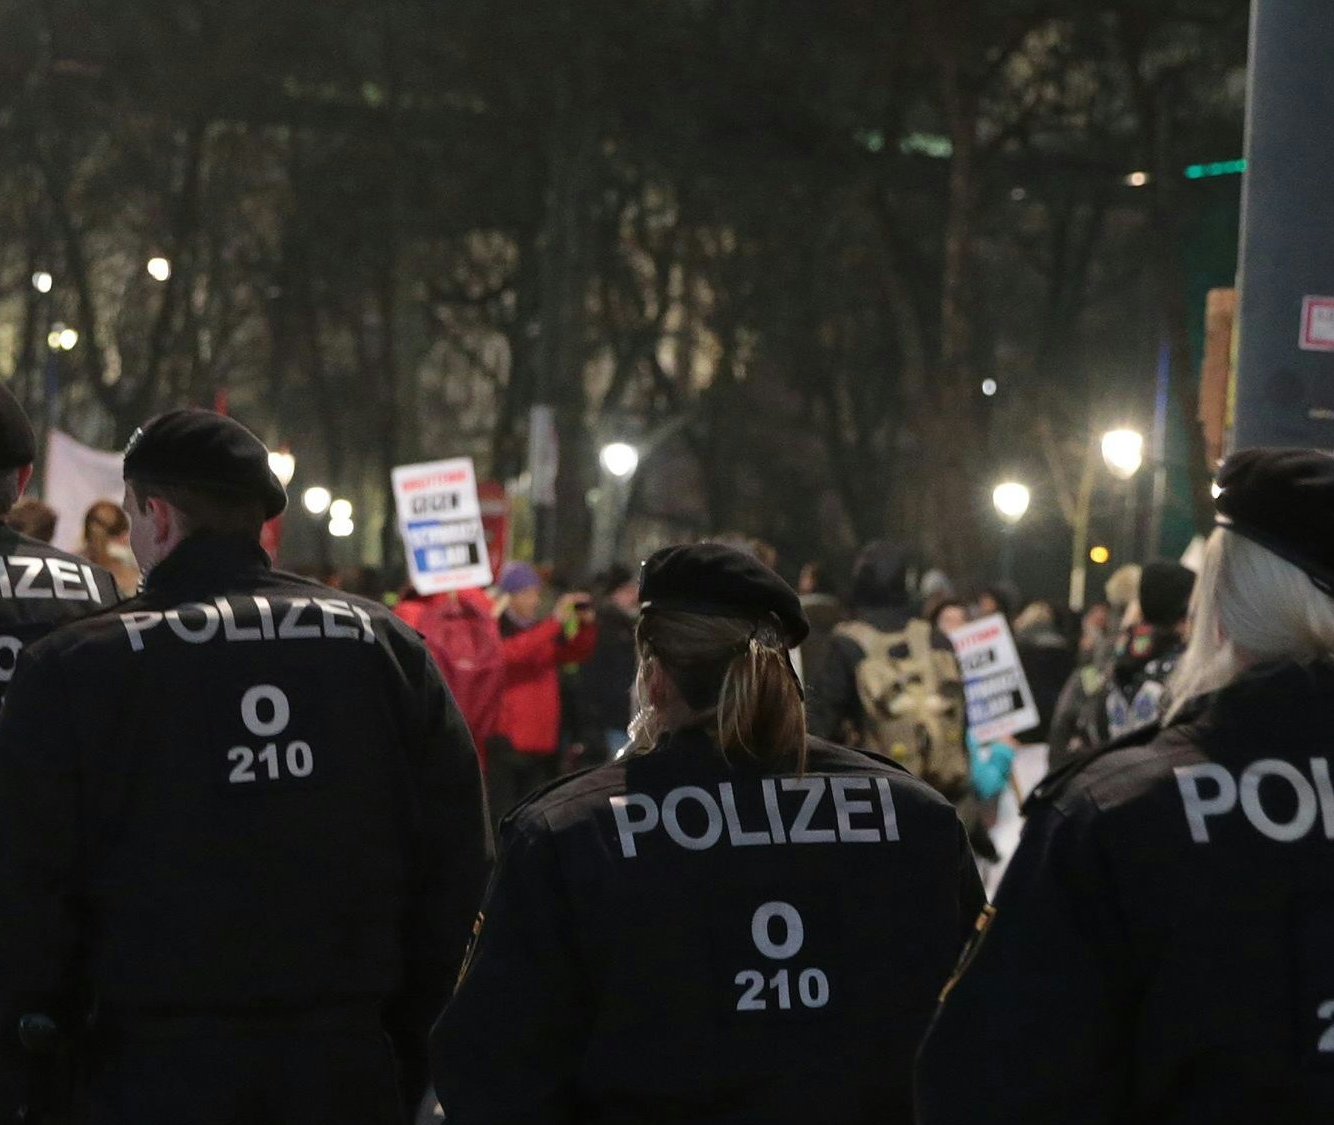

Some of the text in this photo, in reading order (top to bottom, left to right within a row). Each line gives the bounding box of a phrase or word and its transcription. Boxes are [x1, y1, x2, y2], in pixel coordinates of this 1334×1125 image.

[120, 595, 376, 652] POLIZEI
[227, 740, 314, 784] 210
[609, 777, 901, 858] POLIZEI
[734, 968, 830, 1012] 210
